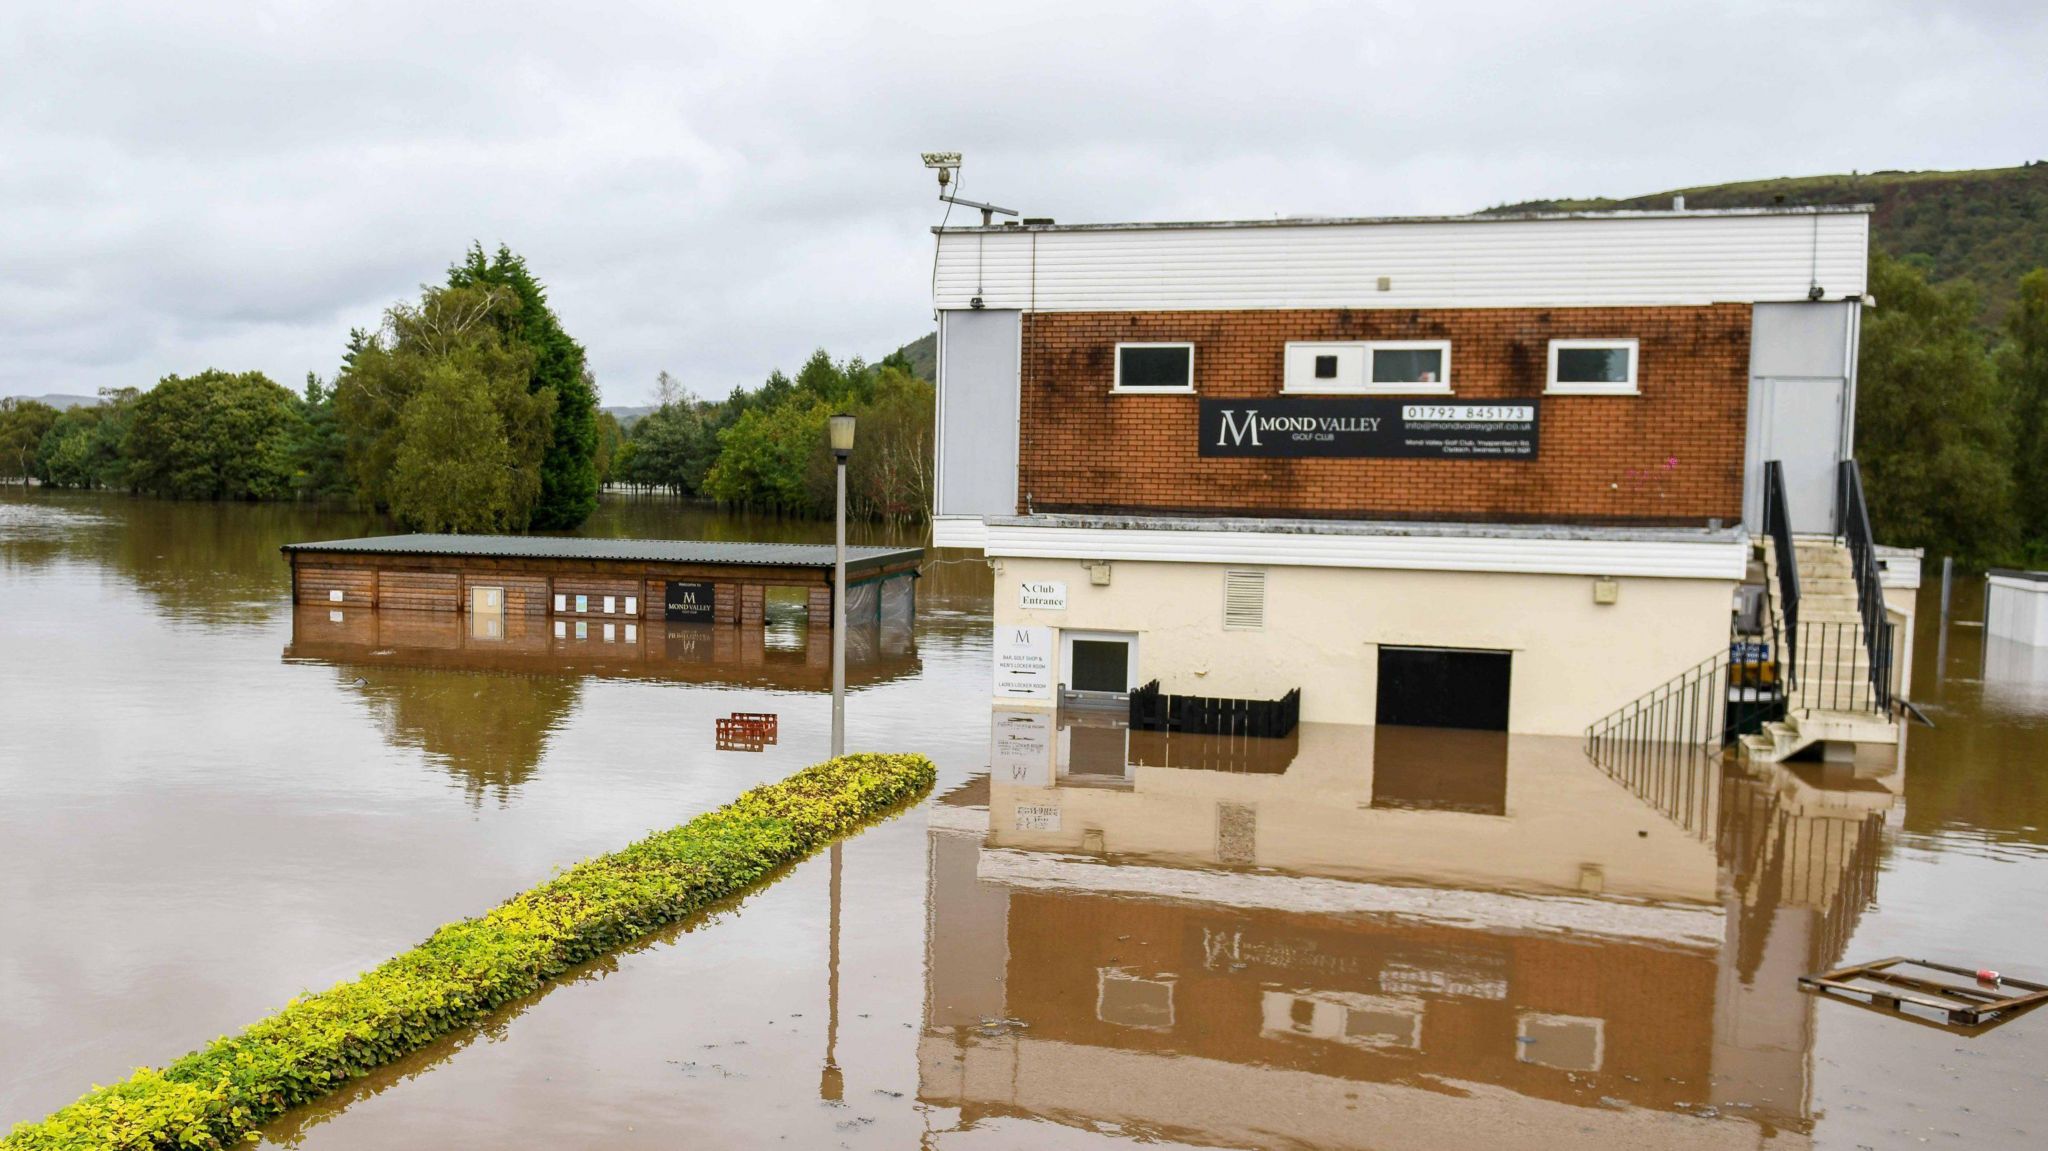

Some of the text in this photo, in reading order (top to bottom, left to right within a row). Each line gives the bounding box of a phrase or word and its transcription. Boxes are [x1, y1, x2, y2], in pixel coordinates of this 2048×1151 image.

[1408, 407, 1524, 419] 01792 845173
[1216, 409, 1263, 446] M
[1260, 417, 1381, 432] MOND VALLEY
[1292, 433, 1335, 441] GOLF CLUB
[1032, 584, 1055, 594] Club
[683, 591, 696, 604] M
[1023, 596, 1063, 606] Entrance
[1015, 630, 1030, 643] M
